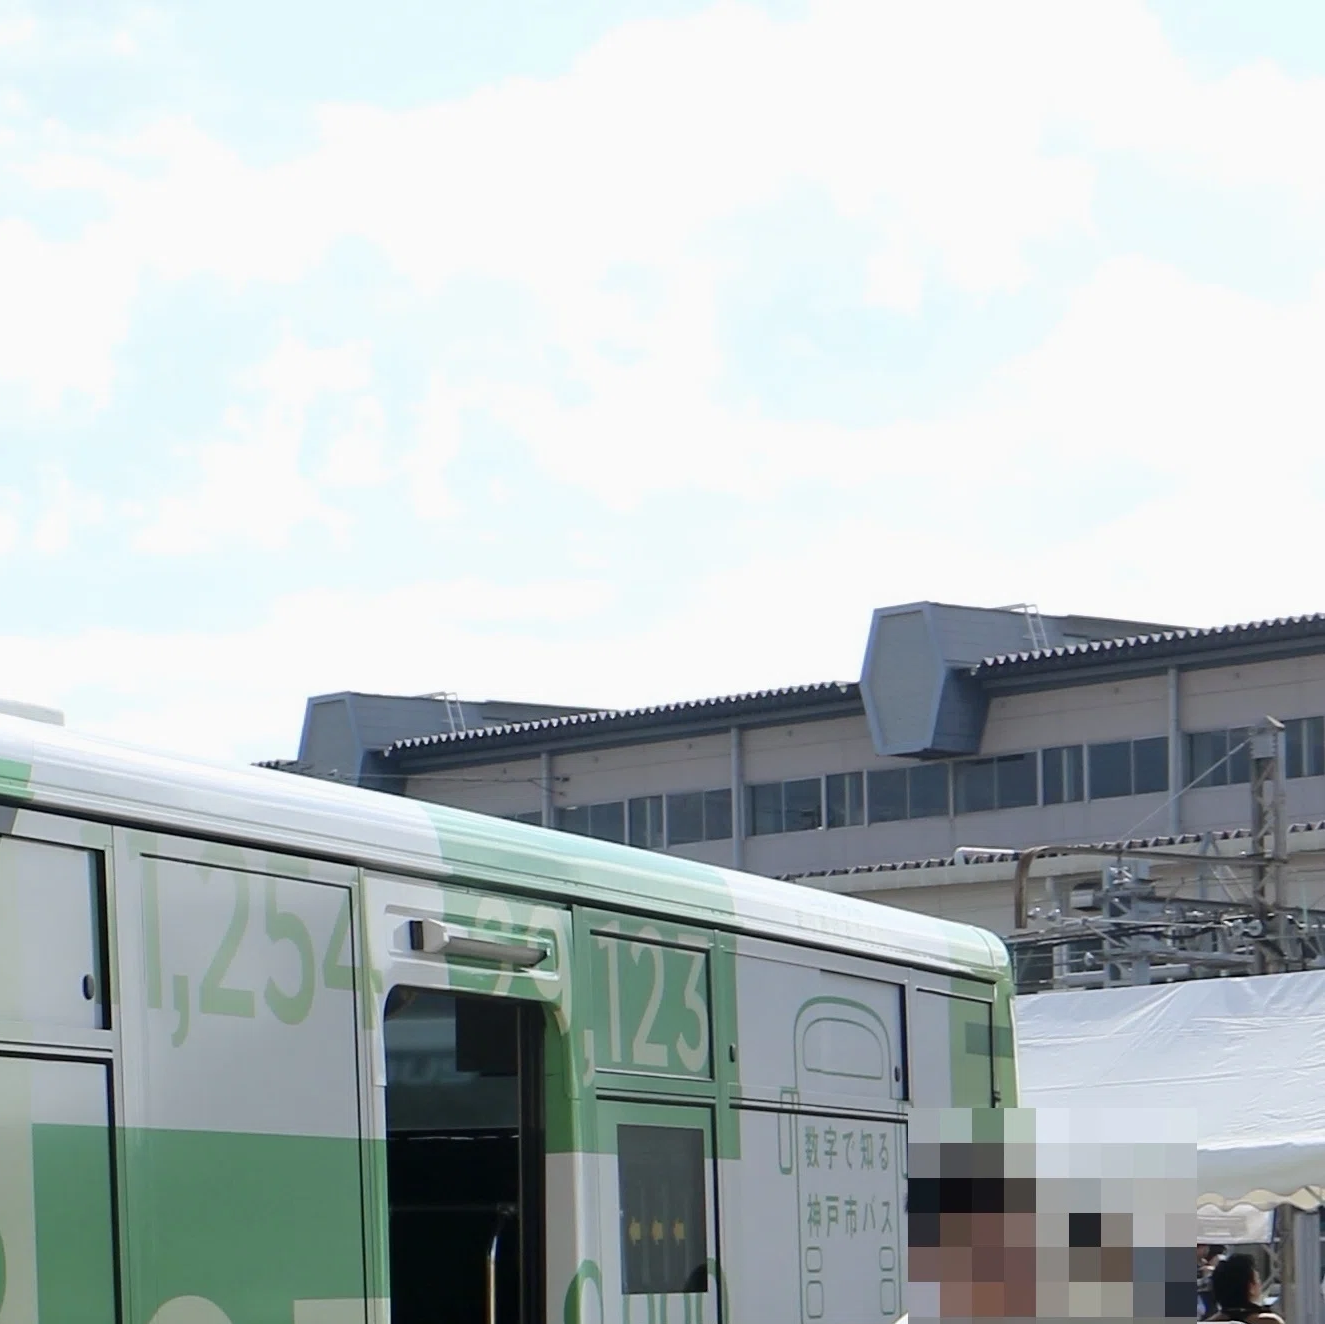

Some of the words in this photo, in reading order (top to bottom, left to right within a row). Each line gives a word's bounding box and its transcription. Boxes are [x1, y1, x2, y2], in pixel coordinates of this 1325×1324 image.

[805, 1126, 889, 1170] 数字で知る
[807, 1193, 892, 1240] 神戸市バス
